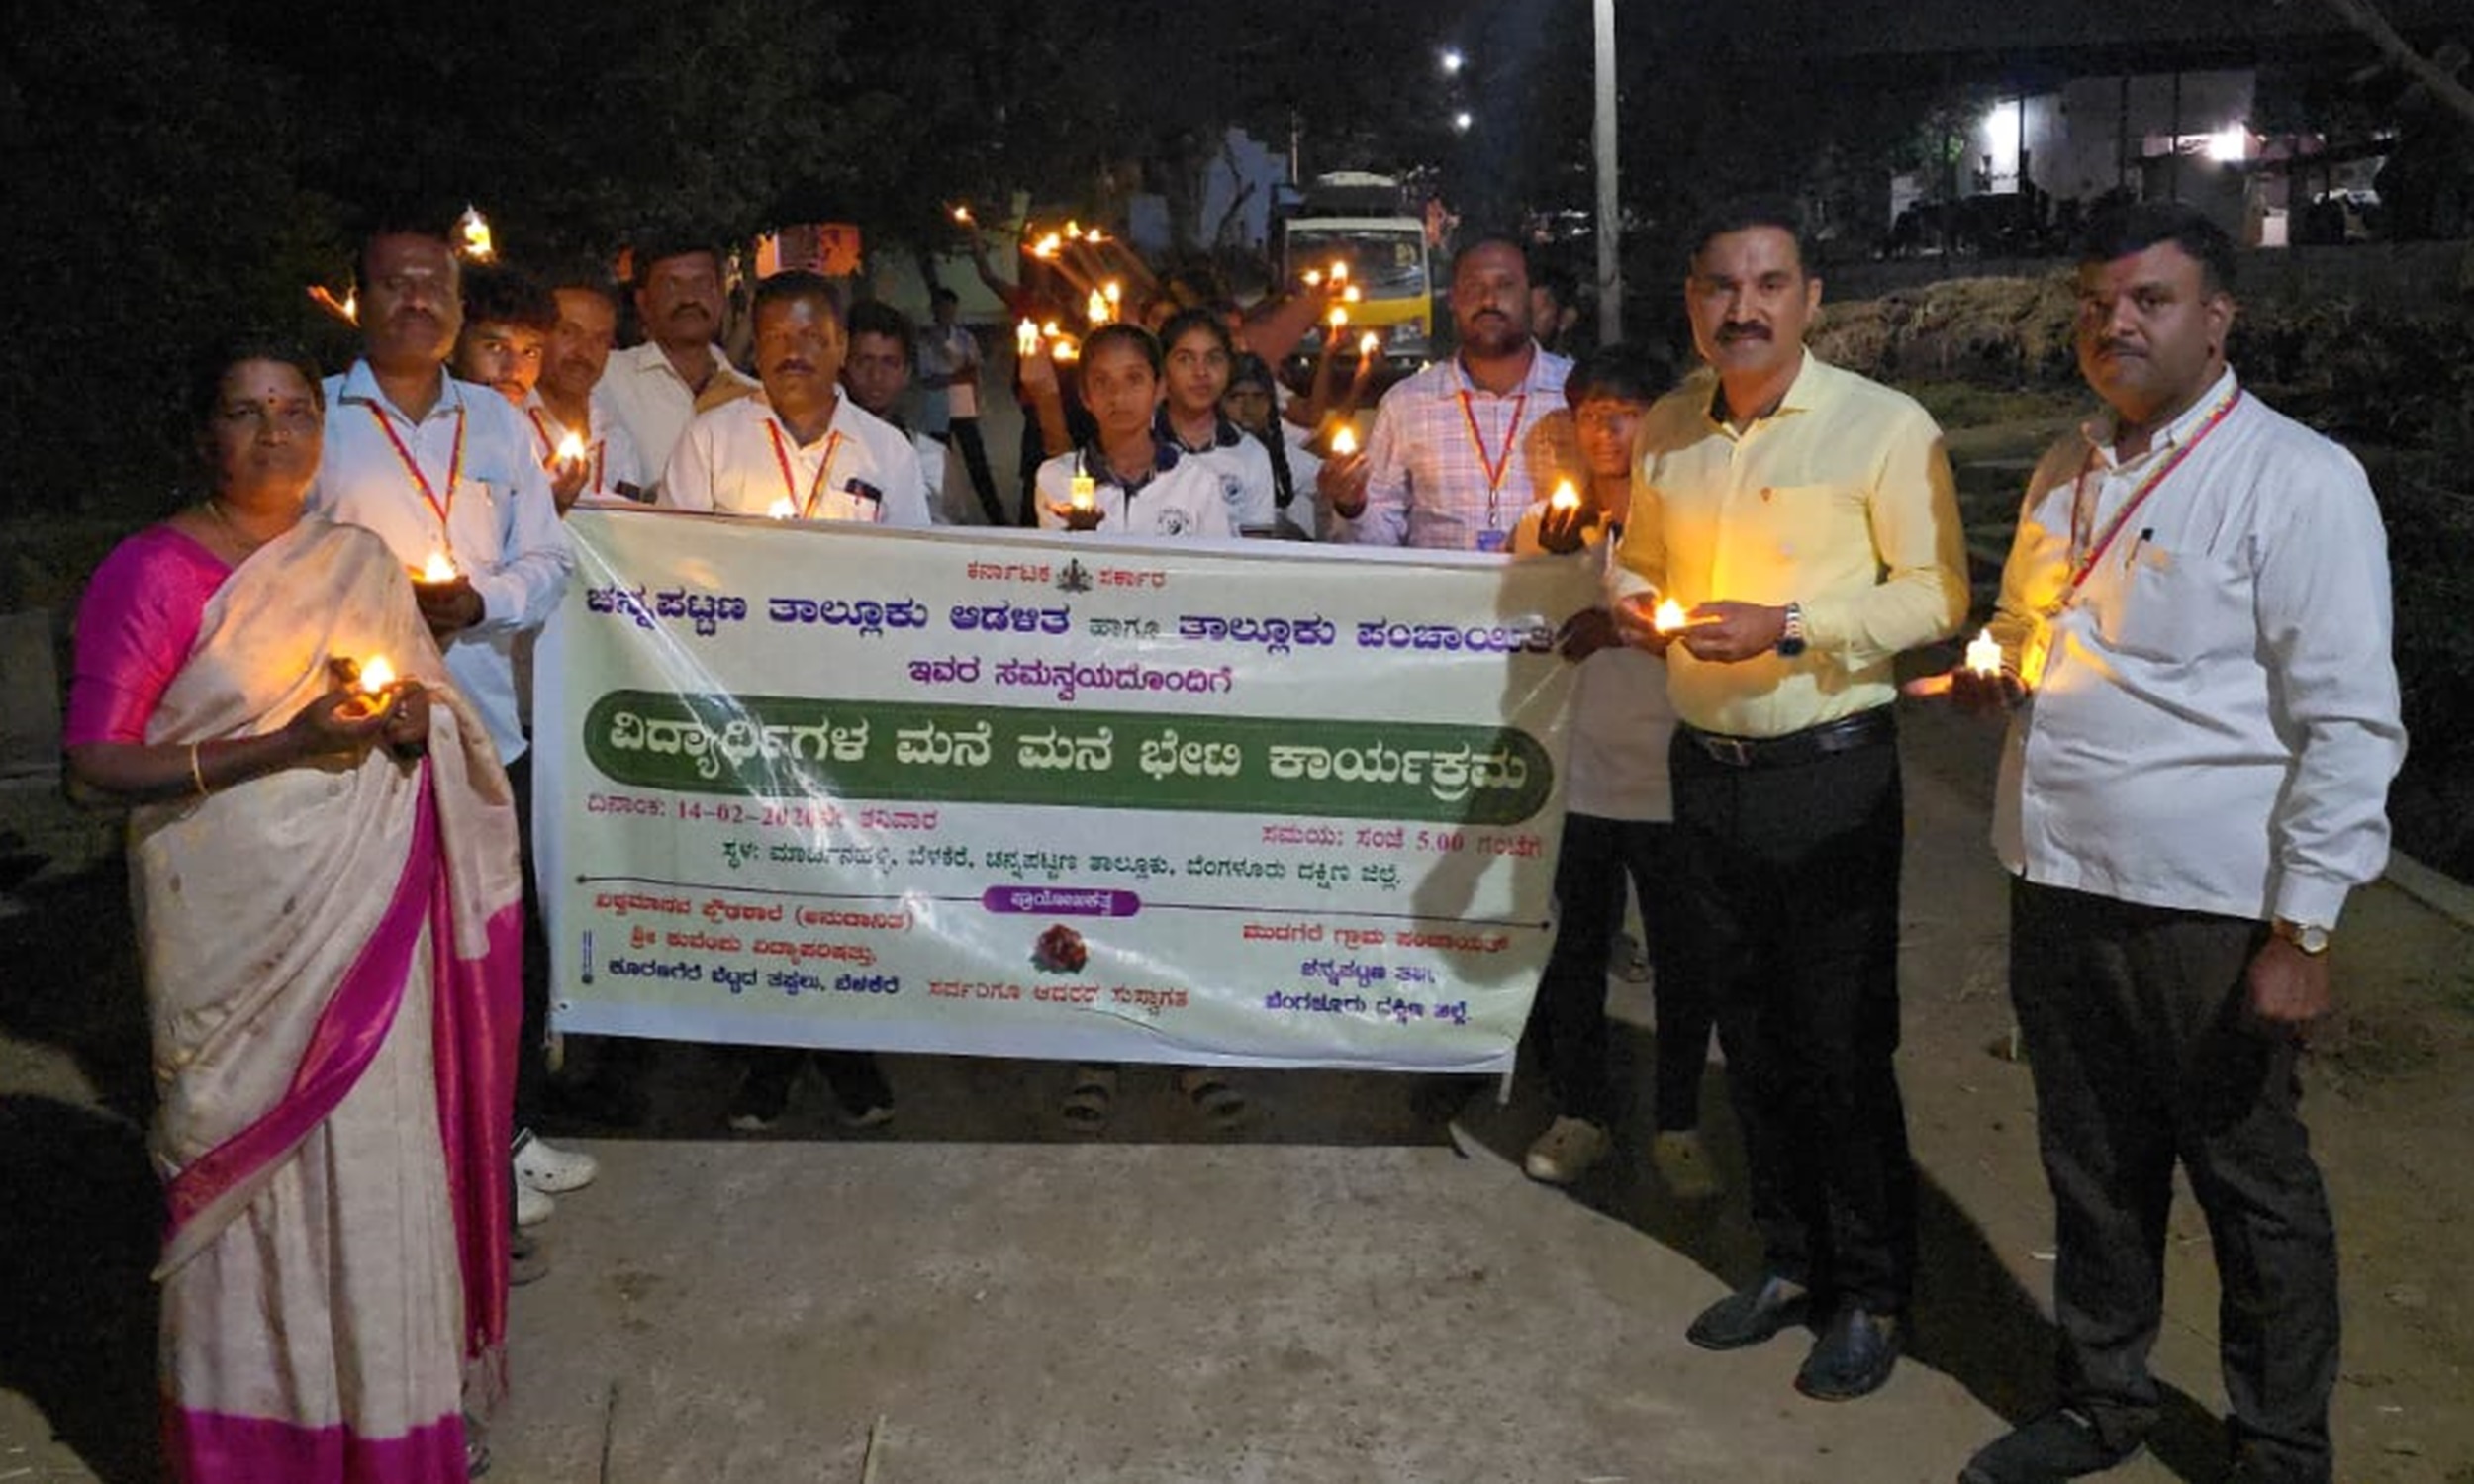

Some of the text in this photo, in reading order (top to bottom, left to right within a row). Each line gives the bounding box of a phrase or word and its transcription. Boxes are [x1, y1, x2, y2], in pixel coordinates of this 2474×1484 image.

[769, 592, 928, 638] ತಾಲ್ಲೂಕು
[950, 600, 1070, 635] ಆಡಳಿತ
[1090, 617, 1161, 639] ಹಾಗೂ
[1179, 612, 1336, 655] ತಾಲ್ಲೂಕು
[908, 654, 1233, 701] ಇವರ ಸಮನ್ವಯದೊಂದಿಗೆ
[610, 709, 1527, 800] ವಿದ್ಯಾರ್ಥಿಗಳ ಮನೆ ಮನೆ ಭೇಟಿ ಕಾರ್ಯಕ್ರಮ
[1417, 830, 1465, 852] 5.00
